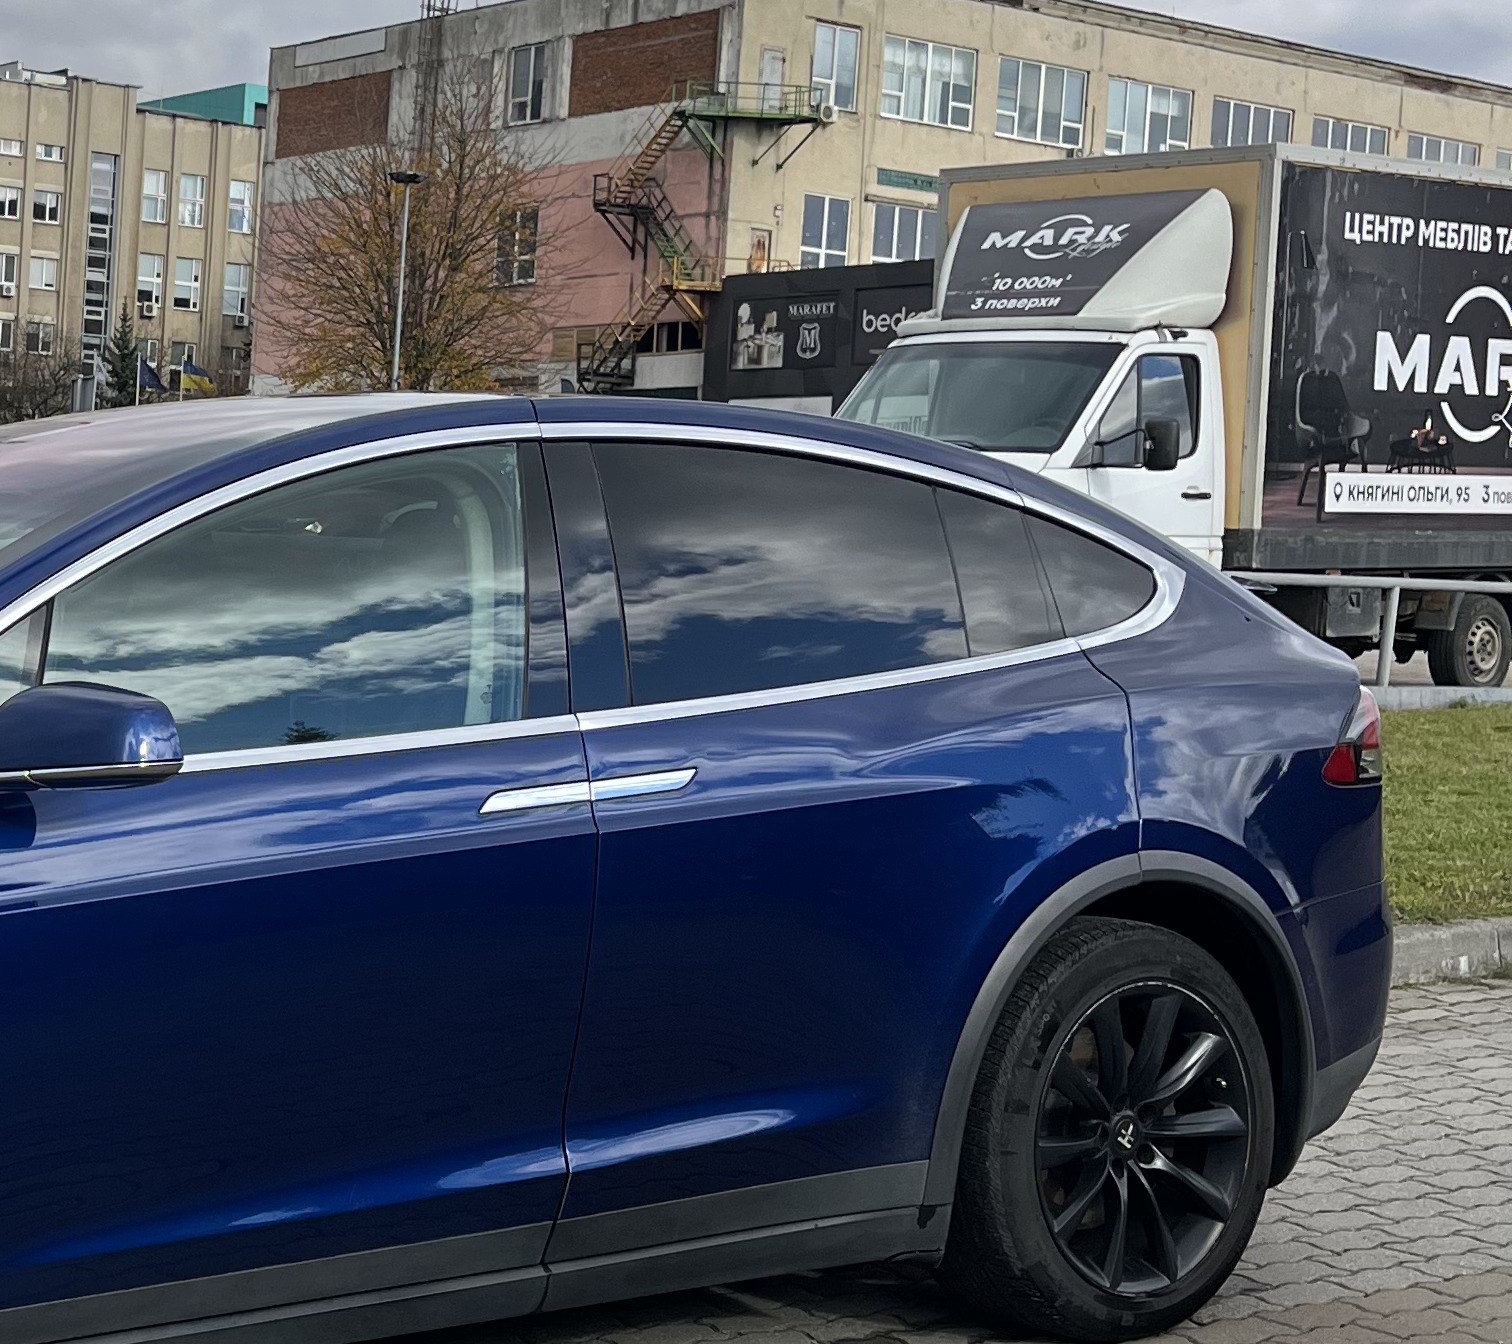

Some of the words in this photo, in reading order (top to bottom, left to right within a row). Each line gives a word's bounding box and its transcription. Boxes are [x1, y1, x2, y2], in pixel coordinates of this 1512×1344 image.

[981, 223, 1131, 250] MARK
[1344, 211, 1415, 245] ЦЕНТР
[1417, 219, 1492, 253] МЕБЛІВ
[788, 301, 836, 316] MARAFET
[971, 297, 982, 311] 3
[986, 296, 1062, 311] поверхи
[1348, 483, 1404, 503] КНЯГИНІ
[1407, 485, 1453, 506] ОЛЬГИ,
[1456, 486, 1470, 503] 95
[1482, 484, 1490, 503] 3
